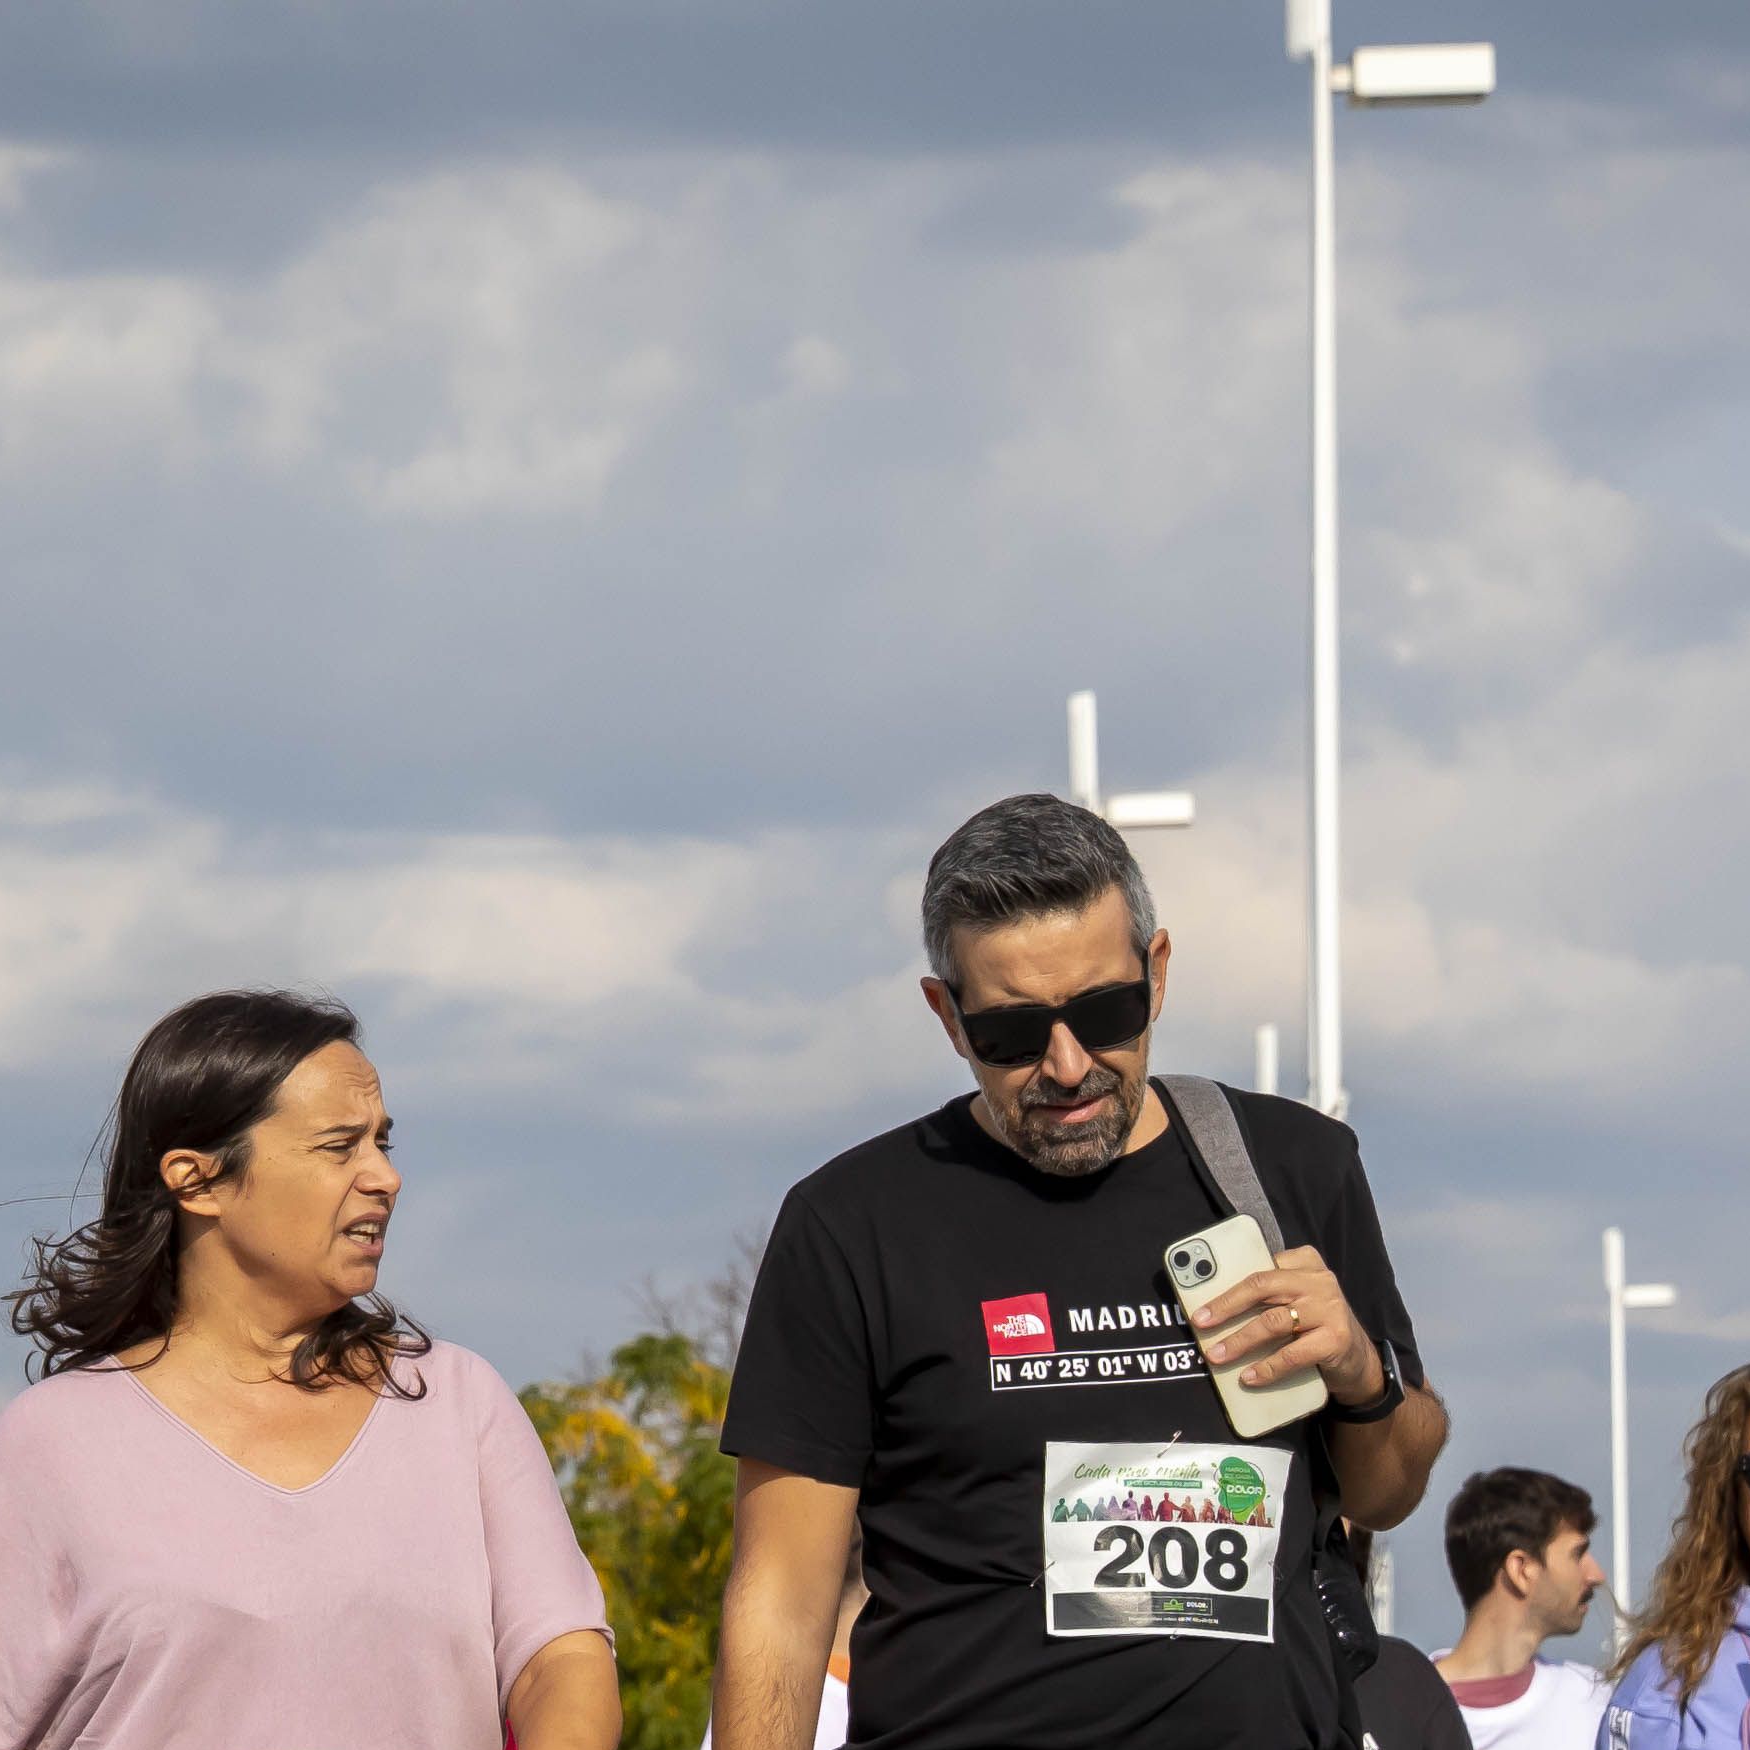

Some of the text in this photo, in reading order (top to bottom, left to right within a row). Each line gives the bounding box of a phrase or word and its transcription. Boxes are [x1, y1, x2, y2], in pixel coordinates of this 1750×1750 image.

[1006, 1314, 1025, 1323] THE
[993, 1321, 1026, 1333] NORTH
[1004, 1328, 1027, 1338] FACE
[995, 1363, 1011, 1382] N
[1020, 1359, 1053, 1380] 40°
[1058, 1358, 1089, 1378] 25'
[1098, 1355, 1131, 1376] 01"
[1137, 1353, 1157, 1373] W
[1164, 1349, 1195, 1371] 03°
[1226, 1484, 1263, 1495] DOLOR
[1093, 1524, 1249, 1592] 208
